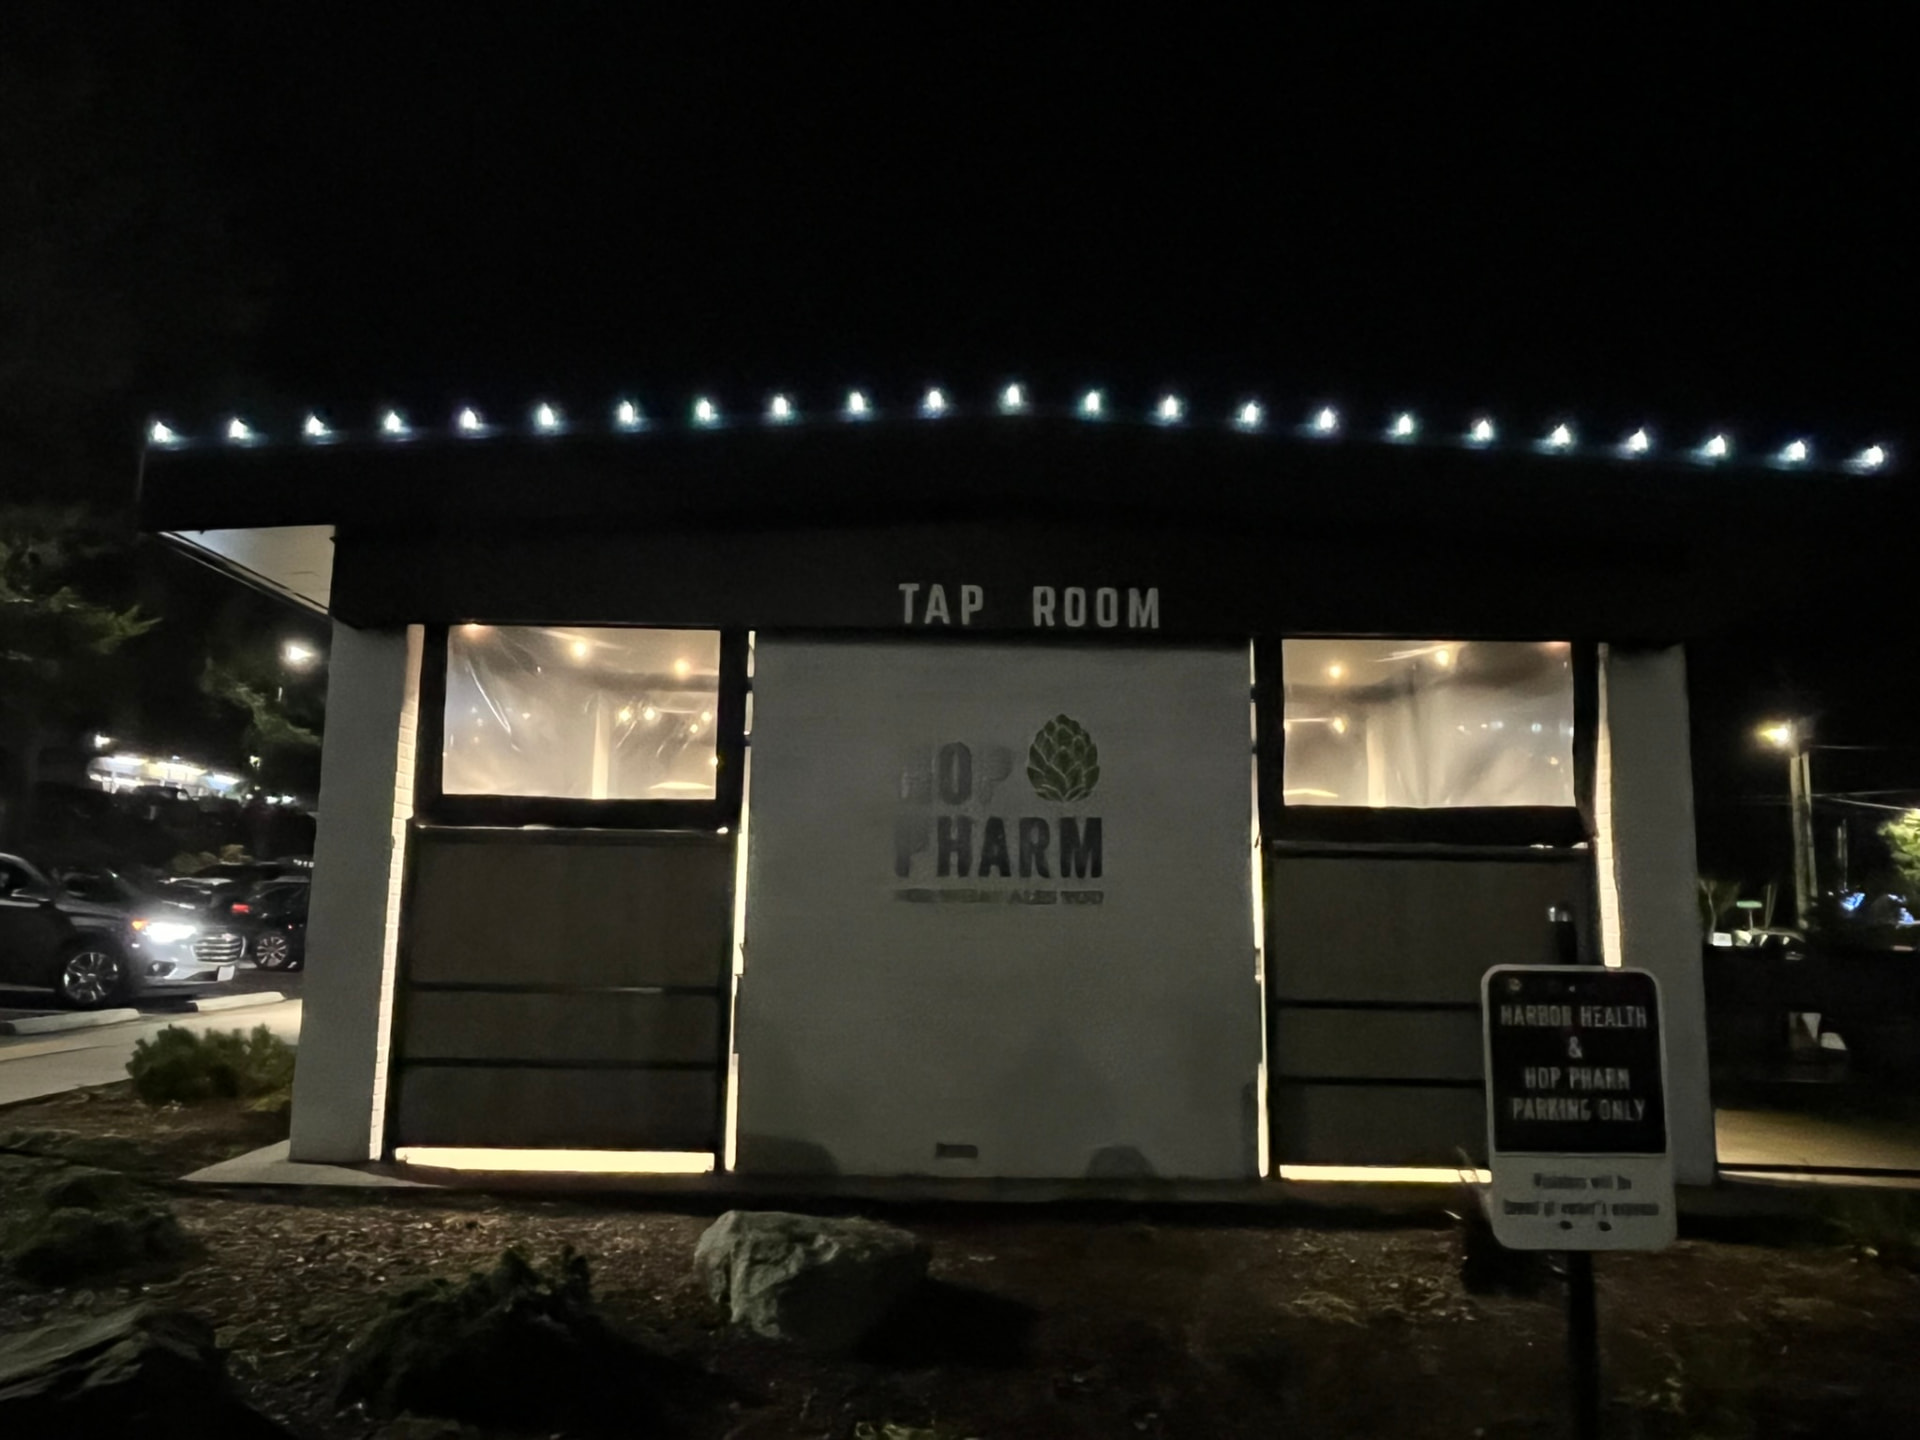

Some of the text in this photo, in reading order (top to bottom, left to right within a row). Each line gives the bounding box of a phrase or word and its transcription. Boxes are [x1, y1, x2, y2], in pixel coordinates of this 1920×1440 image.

[899, 583, 1160, 629] TAP ROOM
[895, 816, 1103, 879] PHARM
[1500, 1004, 1648, 1028] HARBOR HEALTH
[1568, 1036, 1583, 1059] &
[1525, 1066, 1631, 1090] HOP PHARM
[1512, 1097, 1646, 1121] PARKING ONLY
